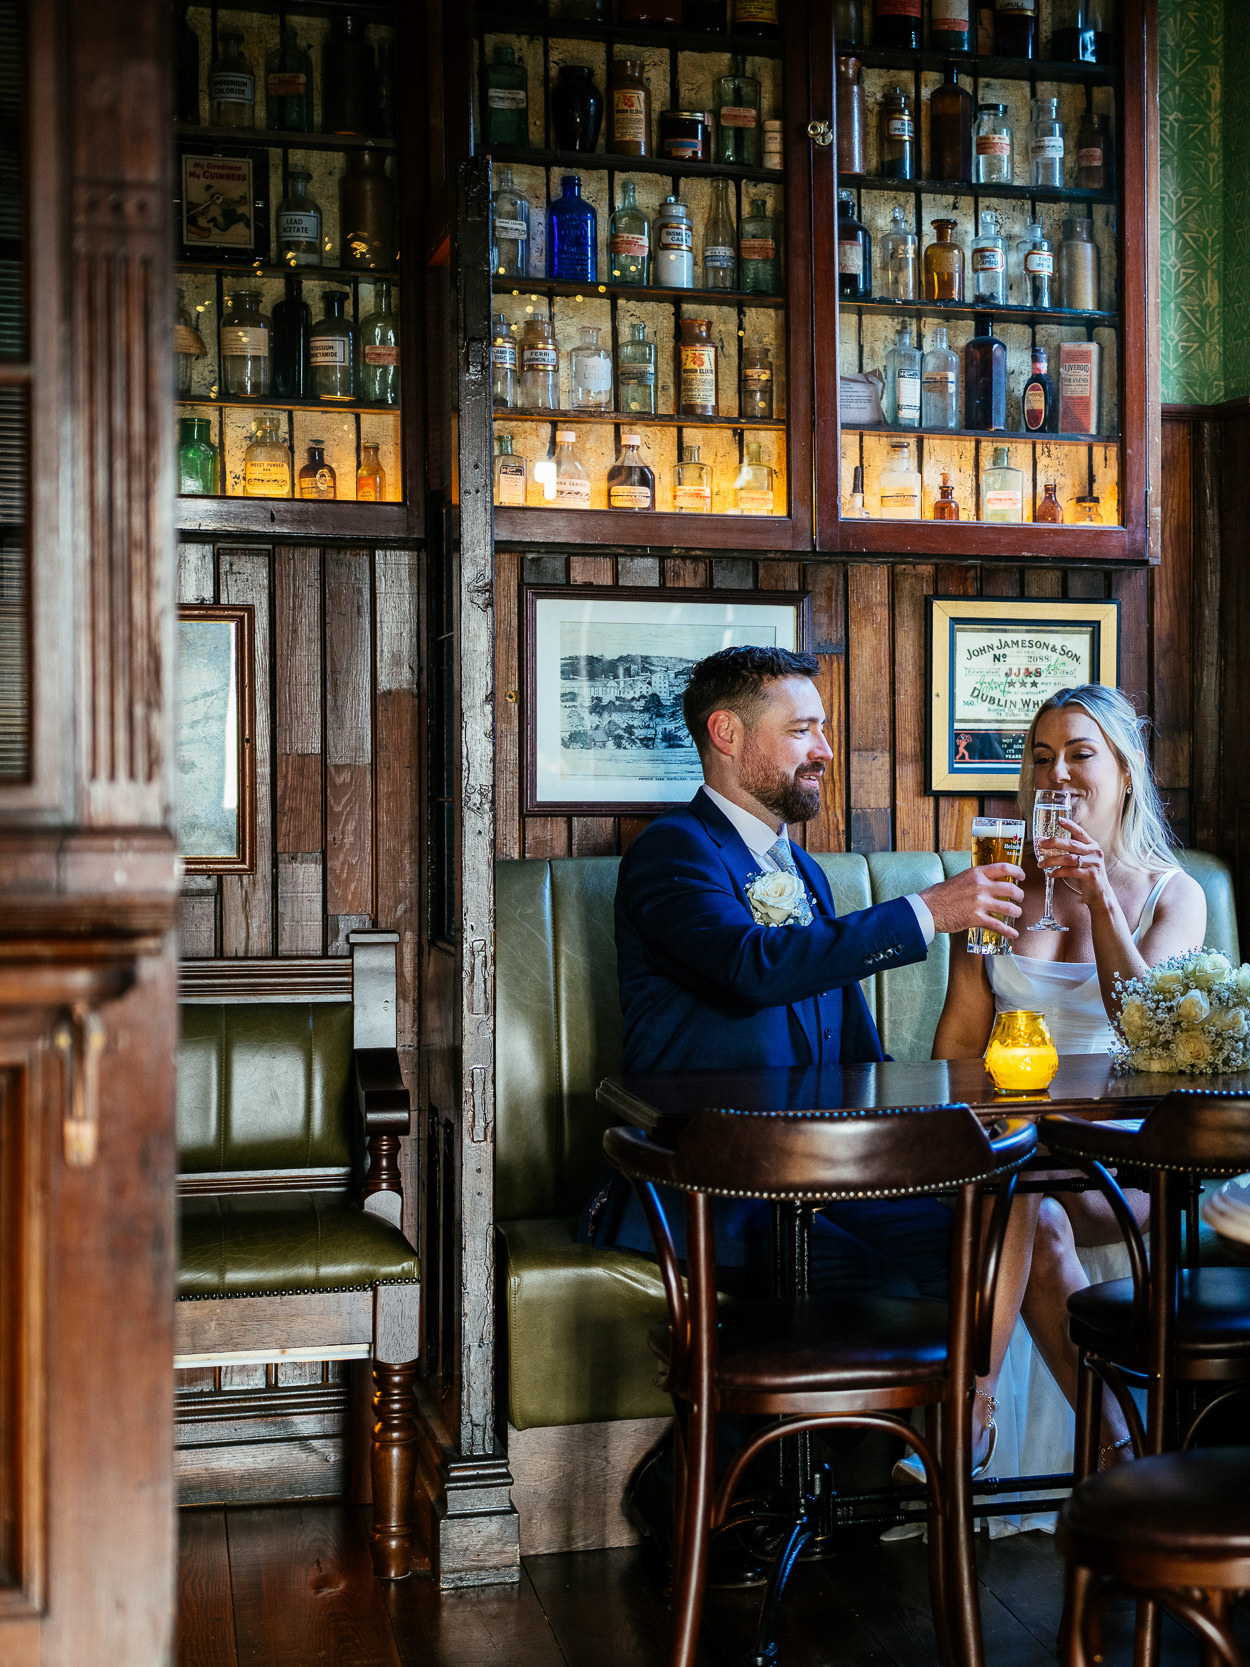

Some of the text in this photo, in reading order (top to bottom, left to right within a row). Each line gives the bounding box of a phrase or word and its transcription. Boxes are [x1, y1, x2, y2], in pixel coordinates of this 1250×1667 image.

[202, 170, 248, 182] GUINNESS
[282, 226, 309, 234] ACETATE
[966, 638, 1081, 665] JOHN JAMESON & SON.
[970, 686, 1017, 709] DUBLIN
